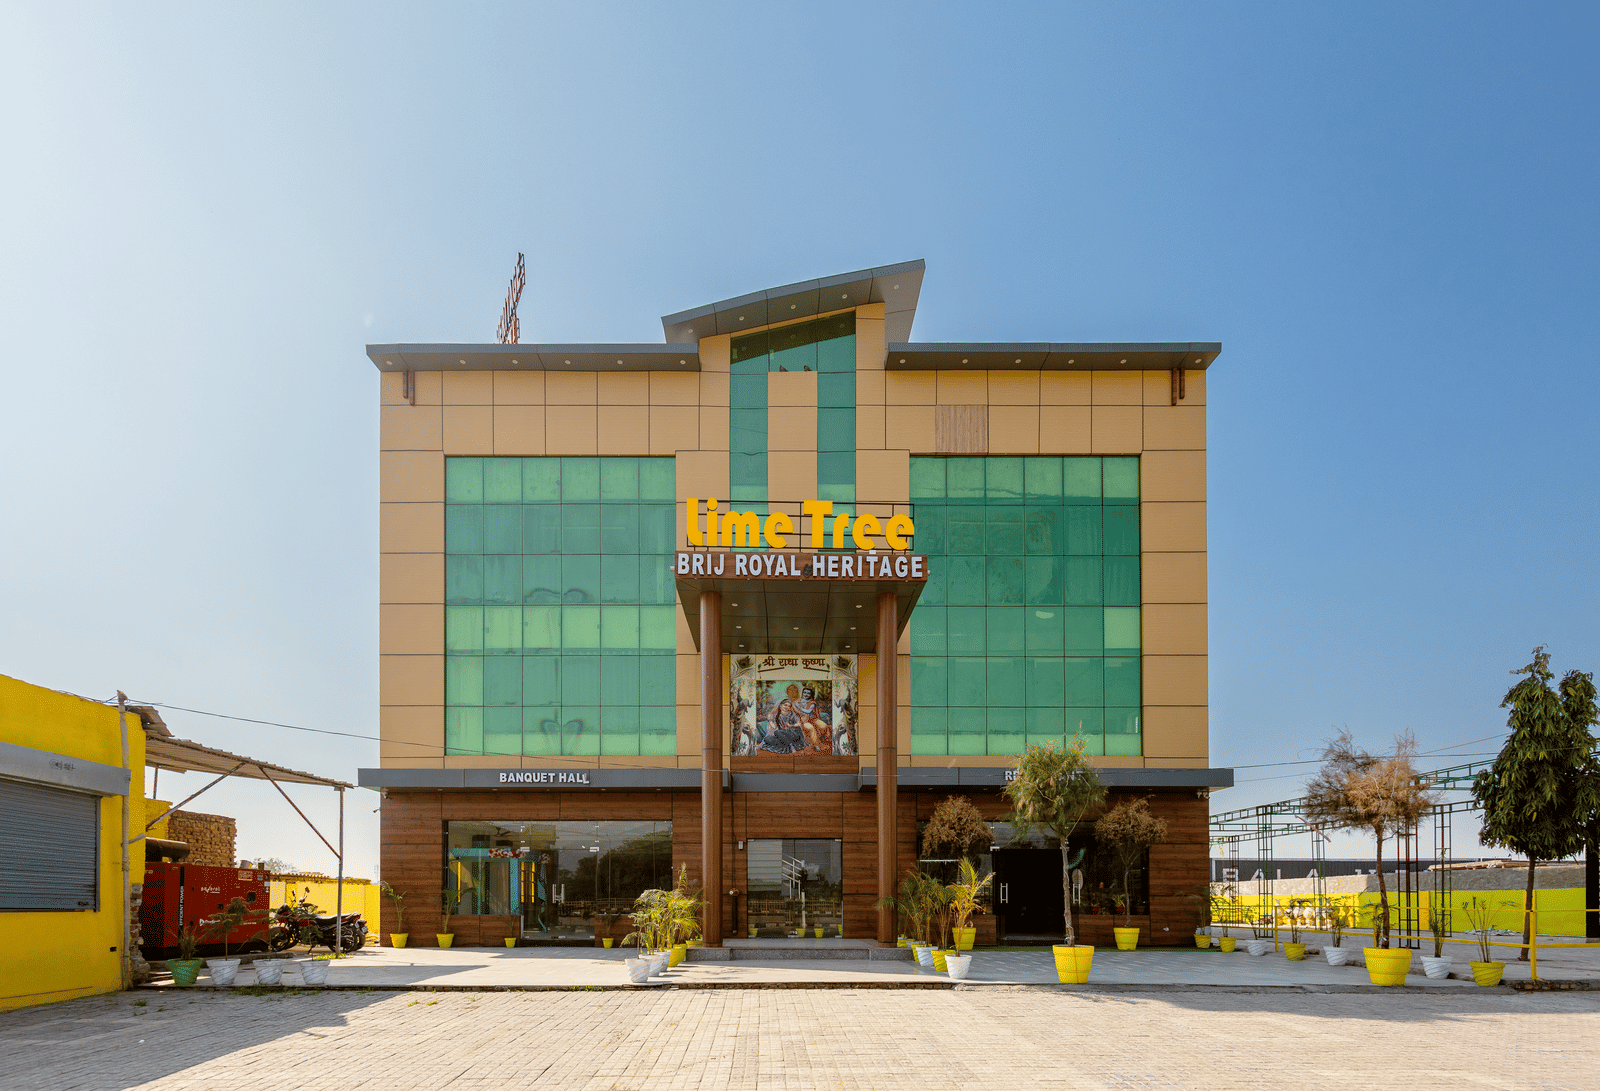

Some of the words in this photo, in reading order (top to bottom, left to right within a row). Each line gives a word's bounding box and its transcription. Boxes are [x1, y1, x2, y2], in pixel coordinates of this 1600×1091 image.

[686, 497, 793, 548] Lime
[803, 500, 915, 550] Tree
[677, 553, 725, 575] BRIJ
[735, 554, 801, 576] ROYAL
[812, 555, 923, 578] HERITAGE
[762, 655, 776, 667] श्री
[778, 658, 799, 667] राधा
[499, 772, 556, 784] BANQUET
[558, 772, 590, 784] HALL
